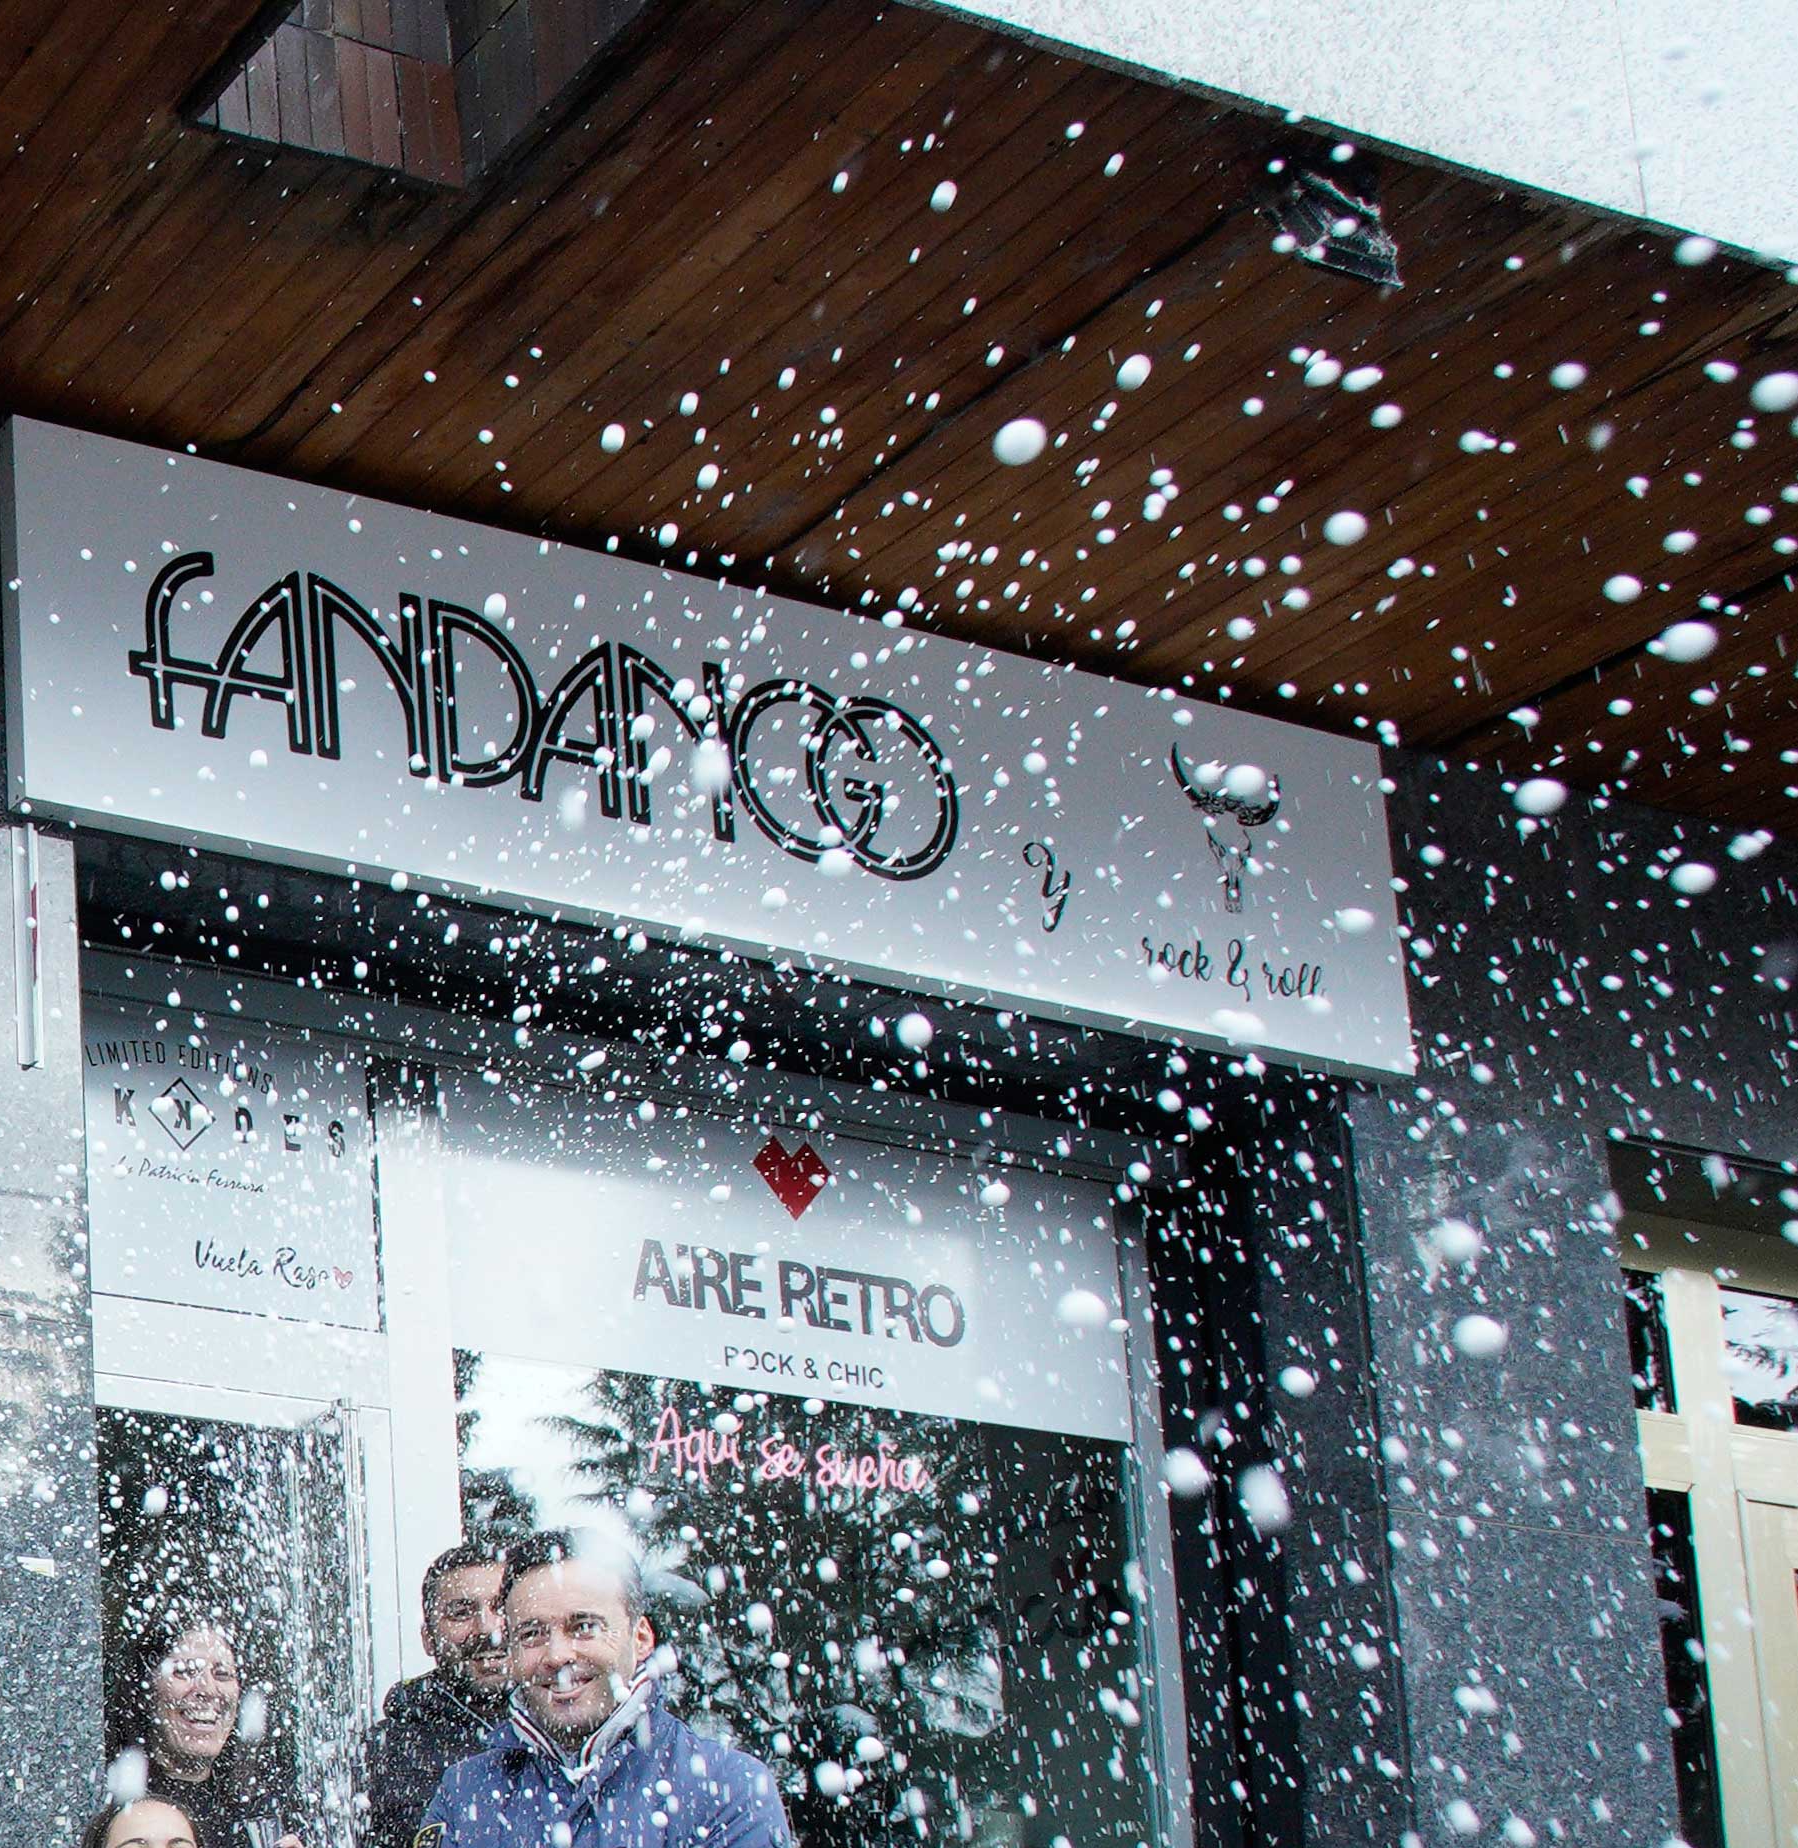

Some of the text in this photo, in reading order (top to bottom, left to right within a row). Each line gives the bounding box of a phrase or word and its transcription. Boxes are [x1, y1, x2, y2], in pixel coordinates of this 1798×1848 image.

[128, 551, 960, 881] FANDANGO
[1142, 937, 1214, 982] rock
[1226, 938, 1251, 1002] &
[1262, 961, 1324, 998] roll
[85, 1041, 167, 1067] LIMITED
[137, 1158, 200, 1184] Patricia
[194, 1237, 264, 1278] Vuela
[633, 1239, 966, 1348] AIRE RETRO
[803, 1357, 819, 1380] &
[827, 1361, 885, 1389] CHIC
[761, 1435, 806, 1480] se
